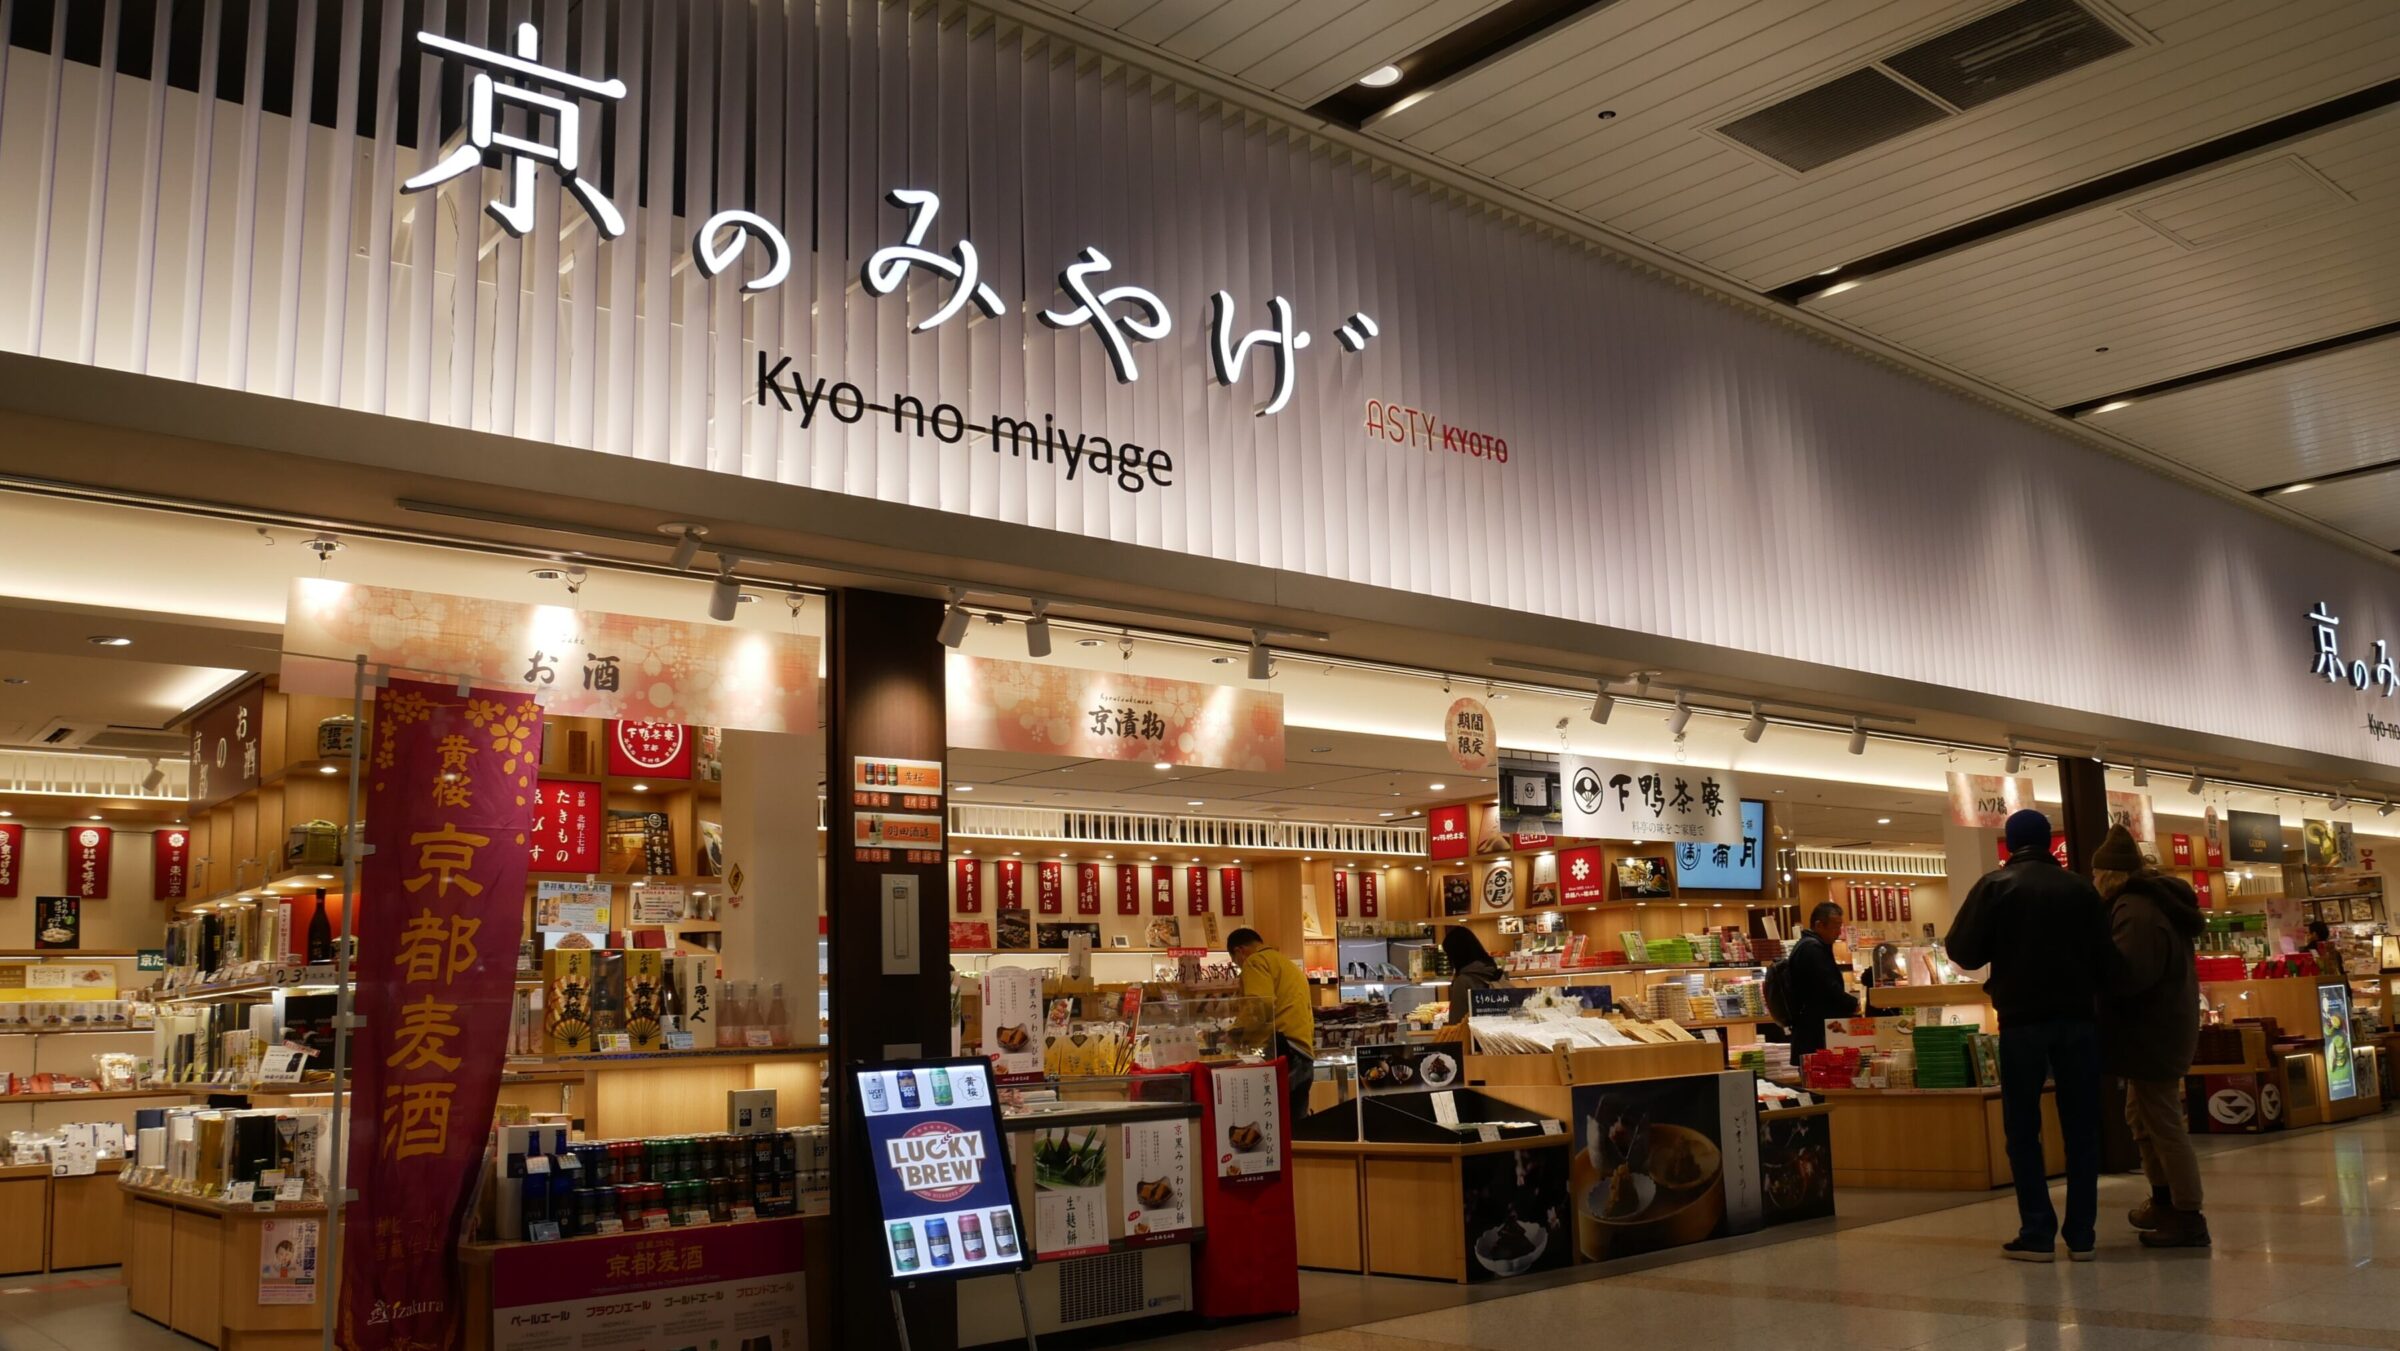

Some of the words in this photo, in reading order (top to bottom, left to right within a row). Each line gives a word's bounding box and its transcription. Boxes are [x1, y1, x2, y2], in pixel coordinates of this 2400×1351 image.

[401, 22, 1378, 417] 京のみやげ
[757, 350, 1173, 493] Kyo-no-miyage
[1366, 400, 1436, 452] ASTY
[1442, 423, 1508, 464] KYOTO
[524, 650, 620, 692] お酒
[1088, 705, 1165, 740] 京漬物
[1457, 712, 1483, 732] 期間
[1457, 736, 1485, 757] 限定
[433, 735, 479, 808] 黄桜
[1609, 773, 1724, 818] 下鴨茶寮
[556, 789, 570, 862] たきもの
[1631, 820, 1704, 837] 料亭の味をご家庭で
[383, 822, 491, 1161] 京都麦酒
[1029, 977, 1039, 1068] 京黒みつわらび餅
[892, 1134, 978, 1164] LUCKY
[906, 1159, 974, 1187] BREW
[1173, 1123, 1185, 1224] 京黒みつわらび餅
[607, 1245, 704, 1279] 京都麦酒
